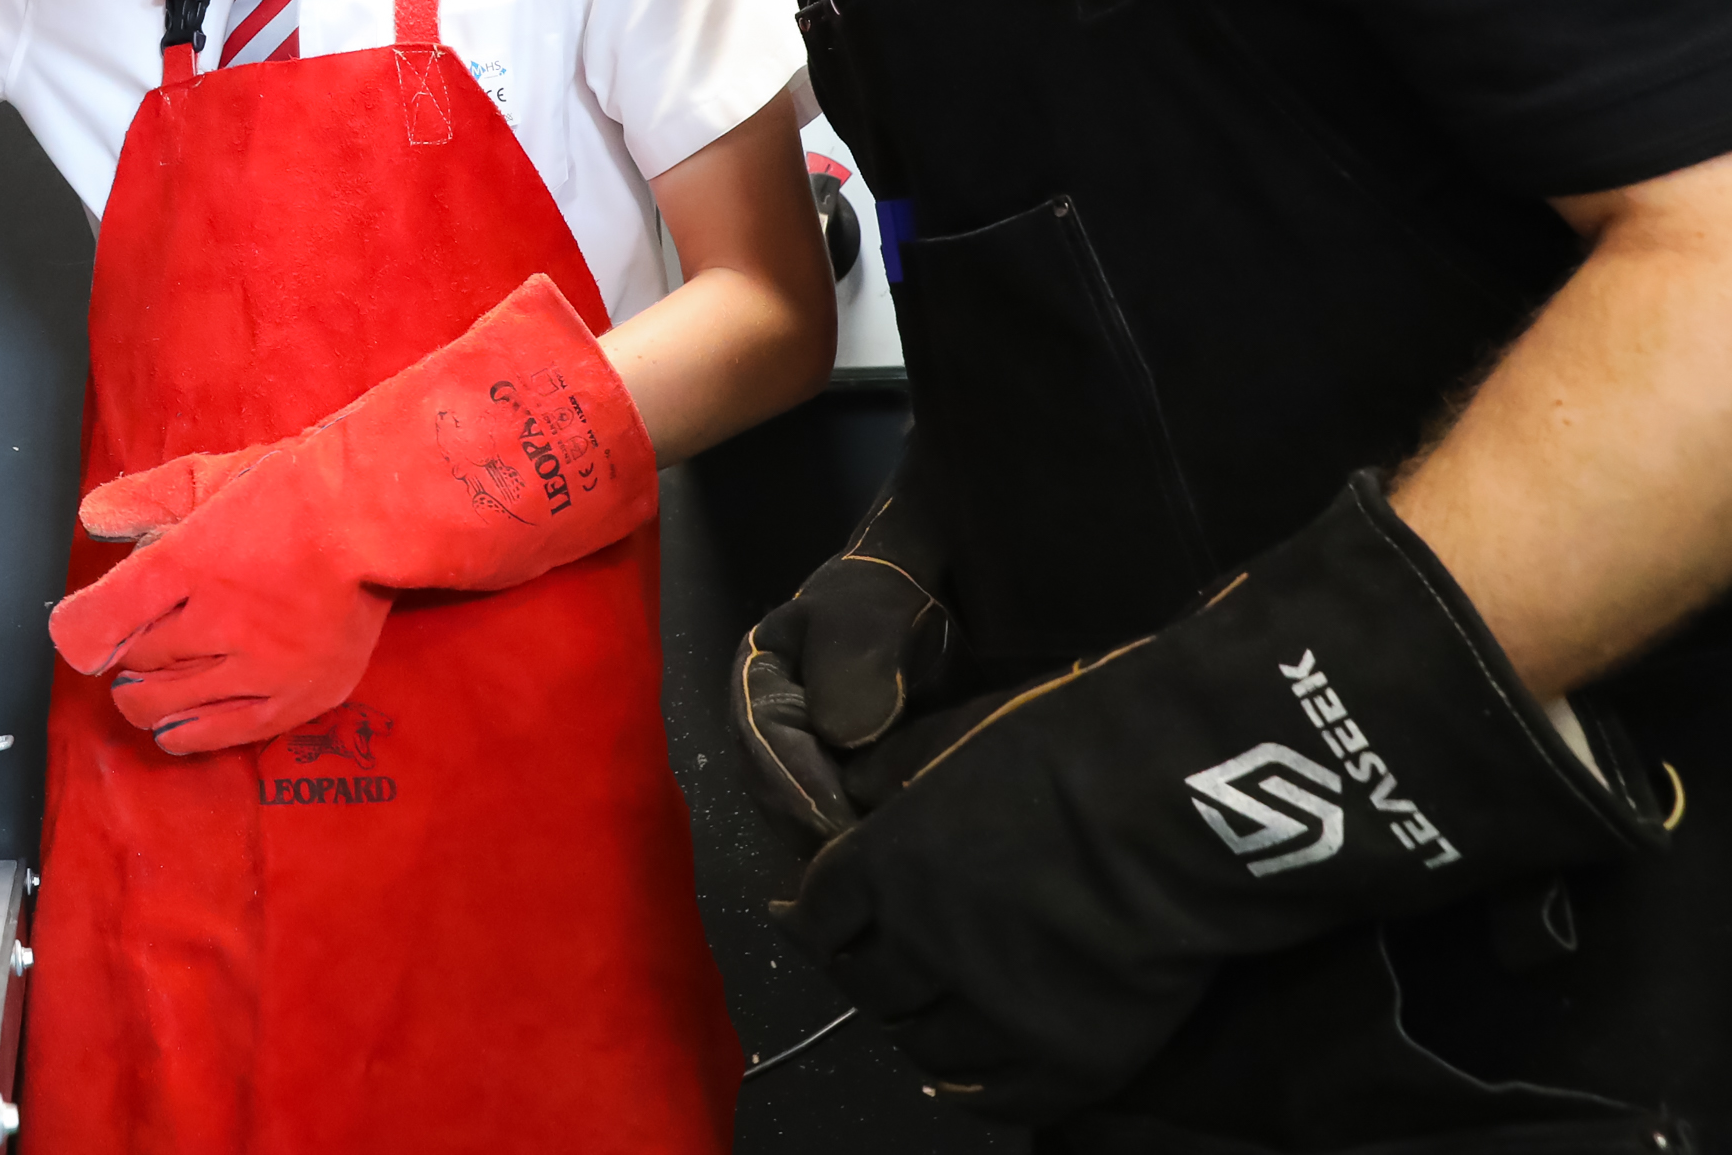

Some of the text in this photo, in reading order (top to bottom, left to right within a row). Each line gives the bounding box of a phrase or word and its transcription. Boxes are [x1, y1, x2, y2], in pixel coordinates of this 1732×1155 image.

[490, 380, 572, 516] LEOPAD
[259, 776, 398, 806] LEOPARD
[1278, 648, 1463, 869] LEASEEK
